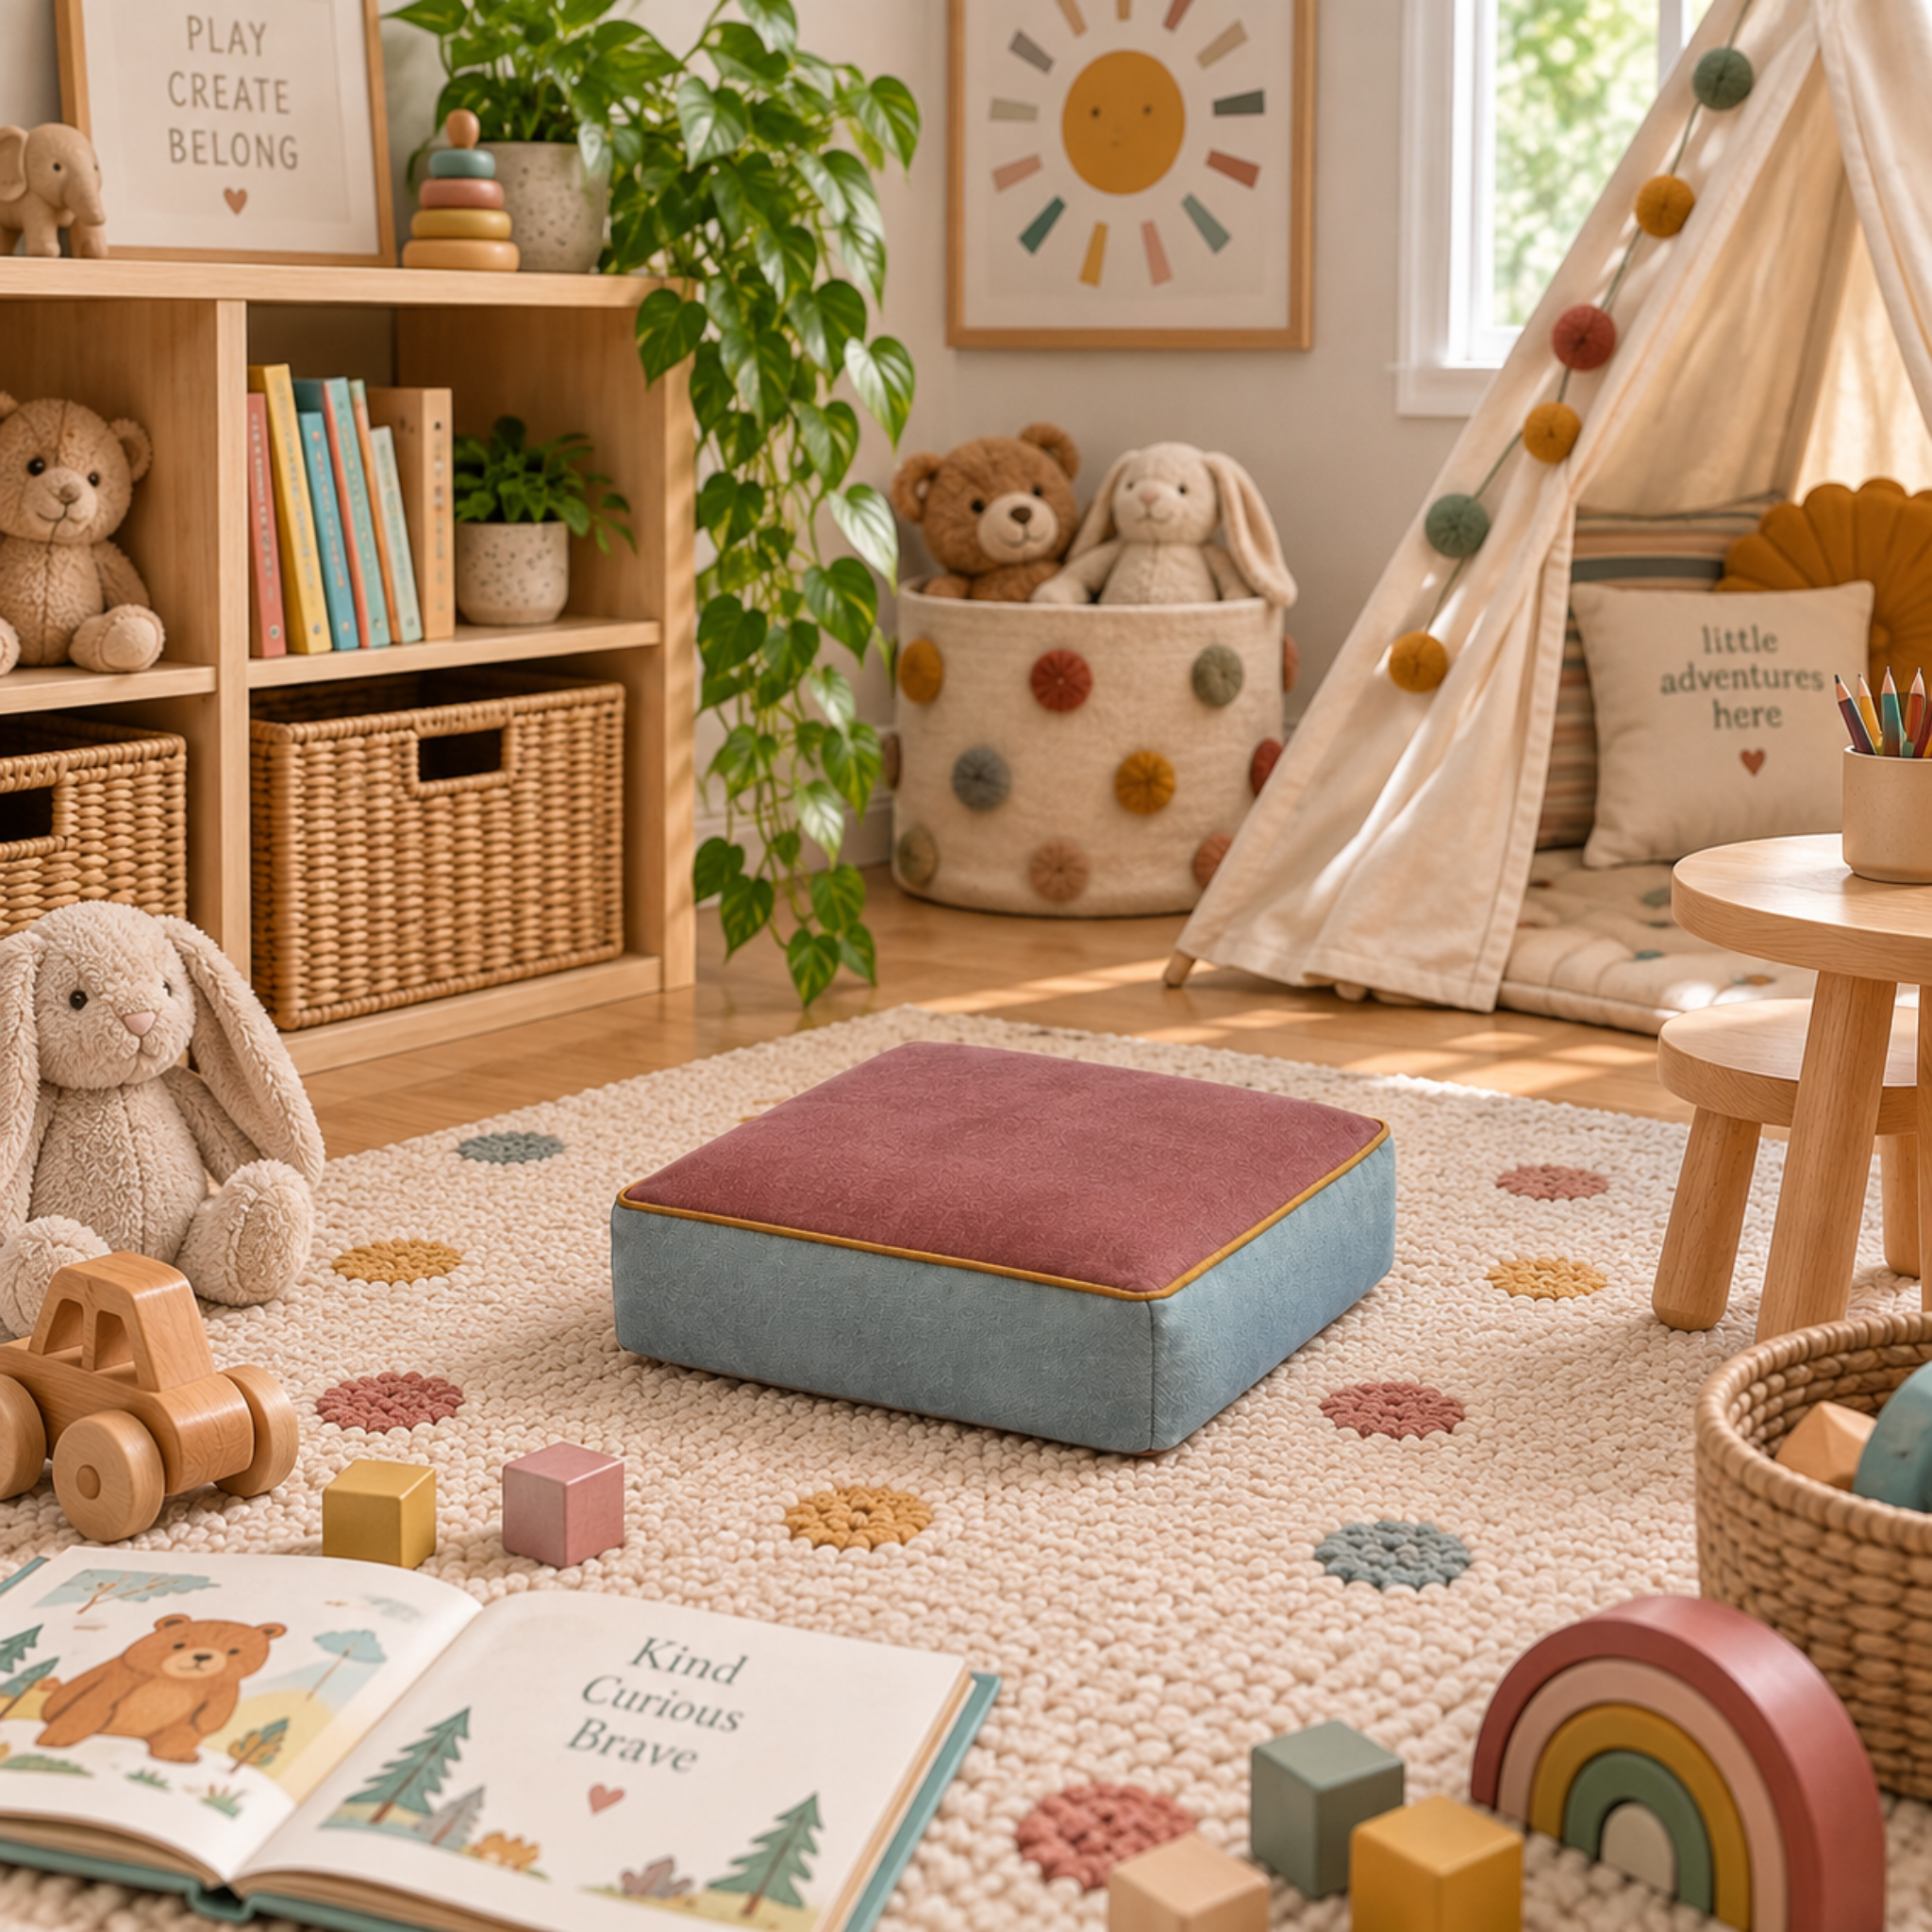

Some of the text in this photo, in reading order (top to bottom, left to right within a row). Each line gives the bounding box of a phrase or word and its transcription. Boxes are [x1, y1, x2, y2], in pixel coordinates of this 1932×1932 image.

[187, 14, 266, 57] PLAY
[168, 71, 291, 115] CREATE
[168, 127, 298, 171] BELONG
[1702, 625, 1779, 654] little
[1660, 661, 1824, 695] adventures
[1713, 699, 1783, 730] here
[626, 1636, 748, 1686] Kind
[581, 1674, 744, 1733] Curious
[565, 1716, 699, 1774] Brave
